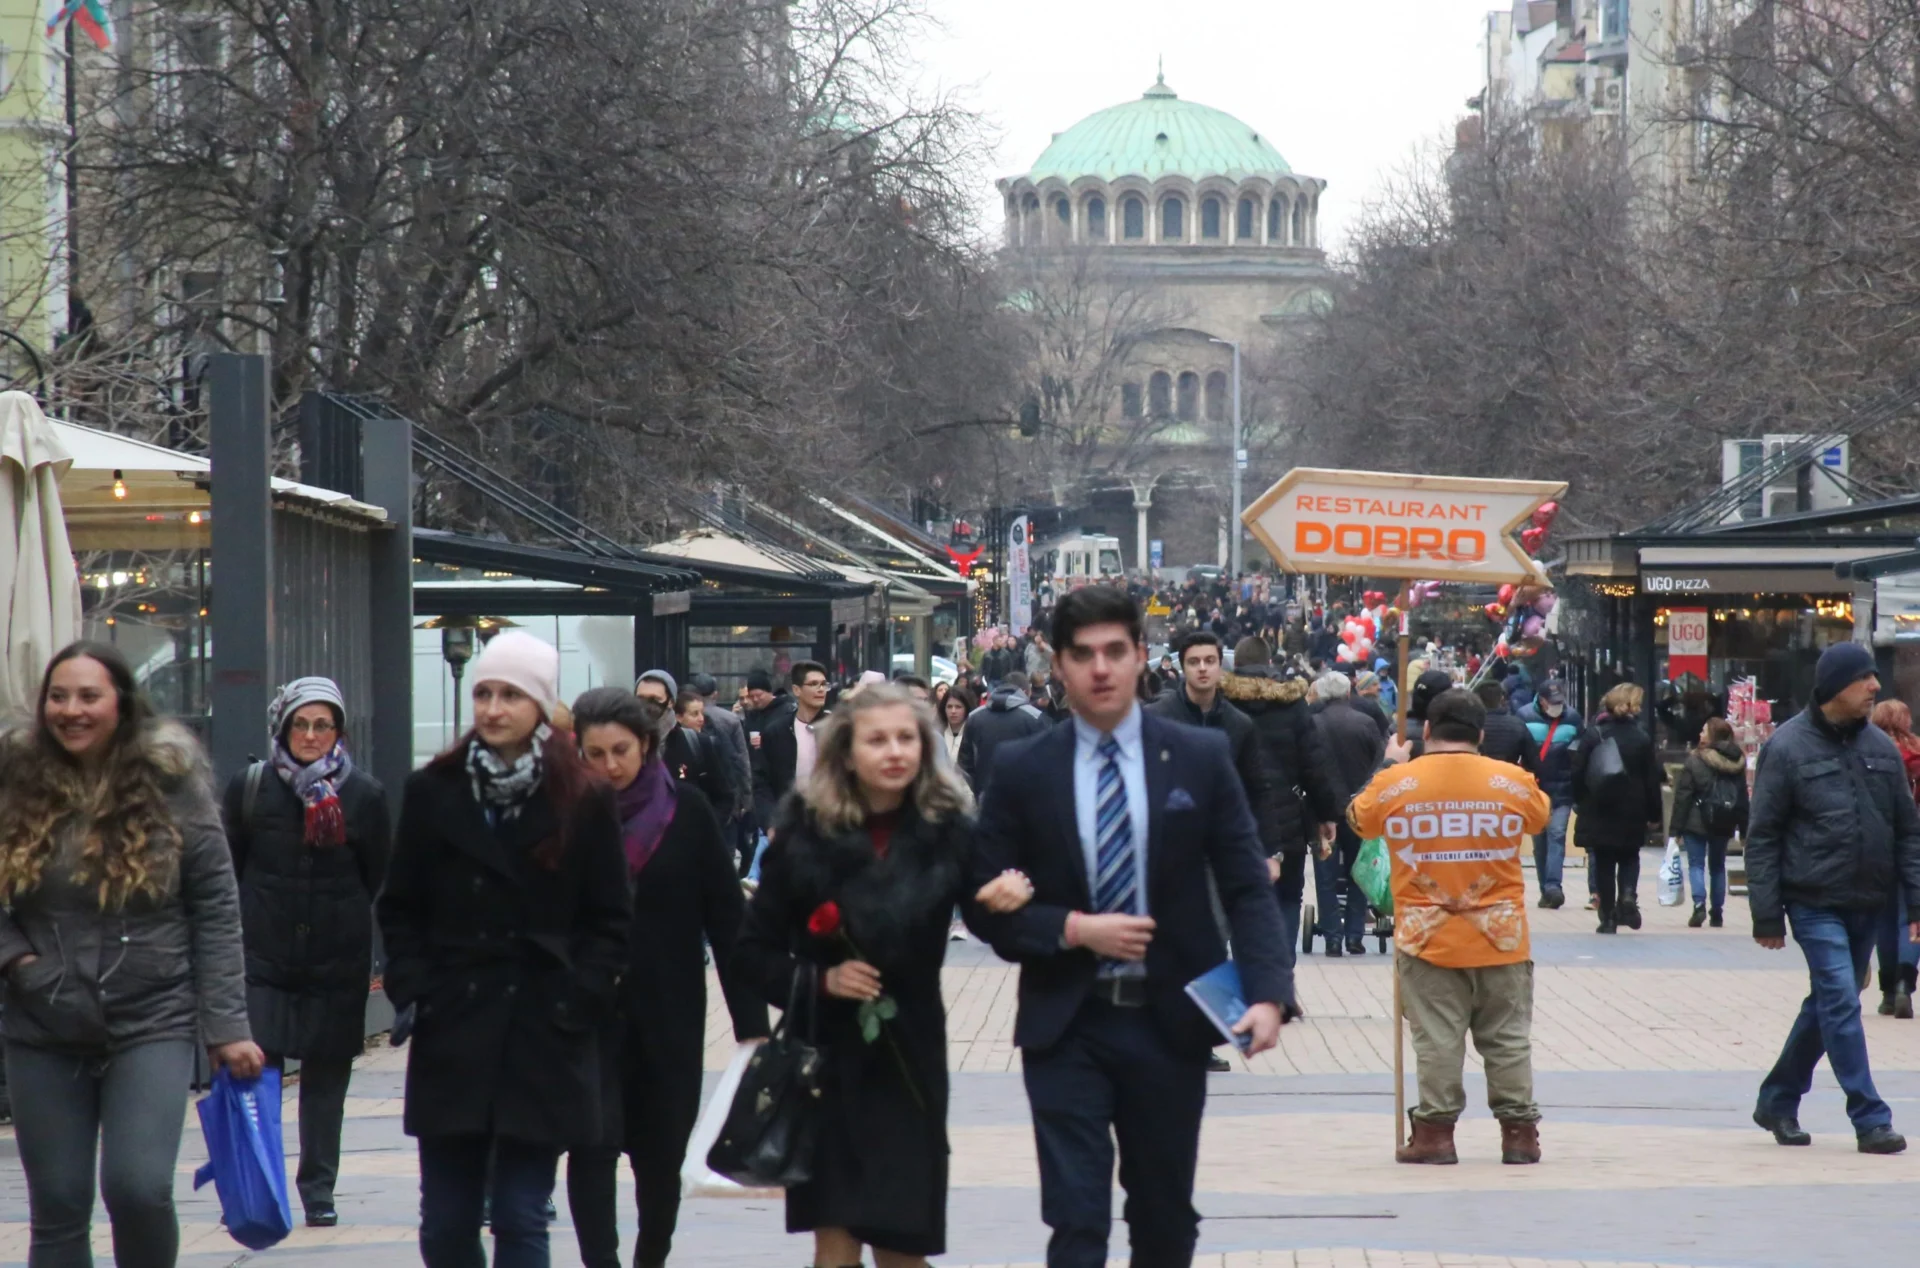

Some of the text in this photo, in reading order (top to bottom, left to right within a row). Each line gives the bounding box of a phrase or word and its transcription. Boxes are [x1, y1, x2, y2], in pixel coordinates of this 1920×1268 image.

[1296, 494, 1488, 521] RESTAURANT
[1295, 521, 1486, 561] DOBRO
[1647, 577, 1710, 591] UGO PIZZA
[1672, 623, 1705, 642] UGO
[1405, 801, 1505, 813] RESTAURANT
